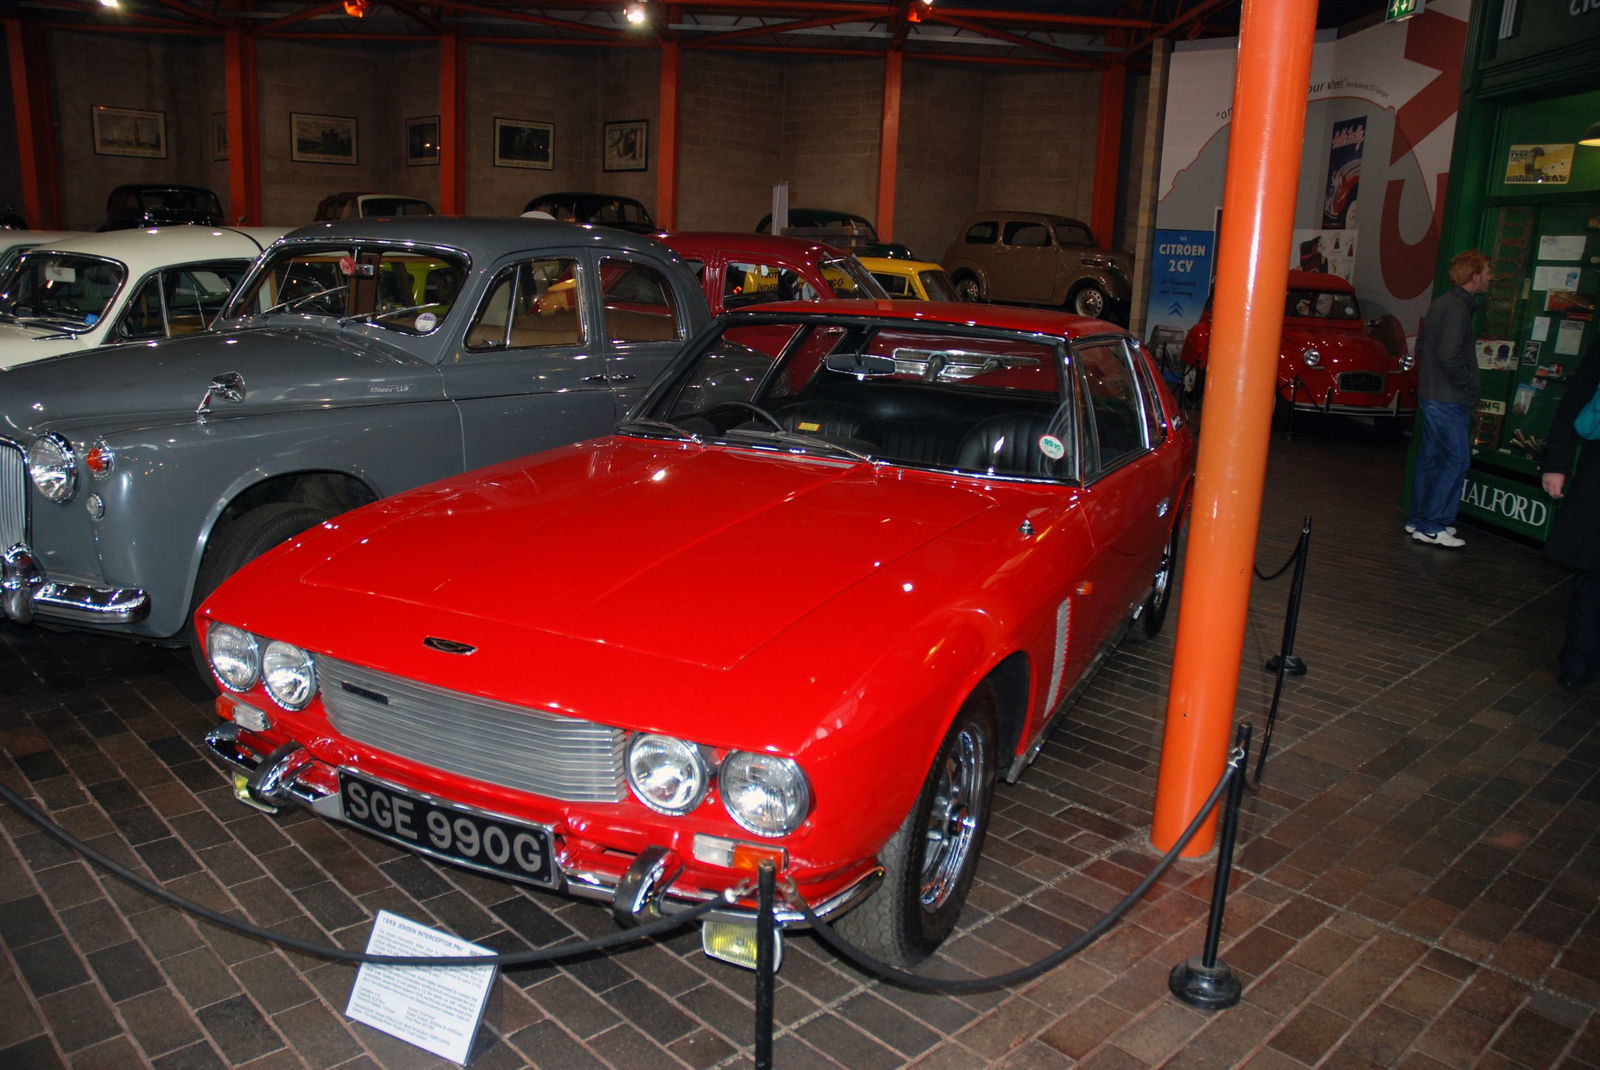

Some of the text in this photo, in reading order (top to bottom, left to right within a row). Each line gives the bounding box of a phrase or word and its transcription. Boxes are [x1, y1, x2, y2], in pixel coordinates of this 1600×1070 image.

[1159, 243, 1206, 257] CITROEN
[1168, 259, 1194, 273] 2CV
[347, 782, 542, 873] SGE 990G
[397, 922, 417, 935] JENSEN
[417, 930, 453, 948] INTERCEPTOR
